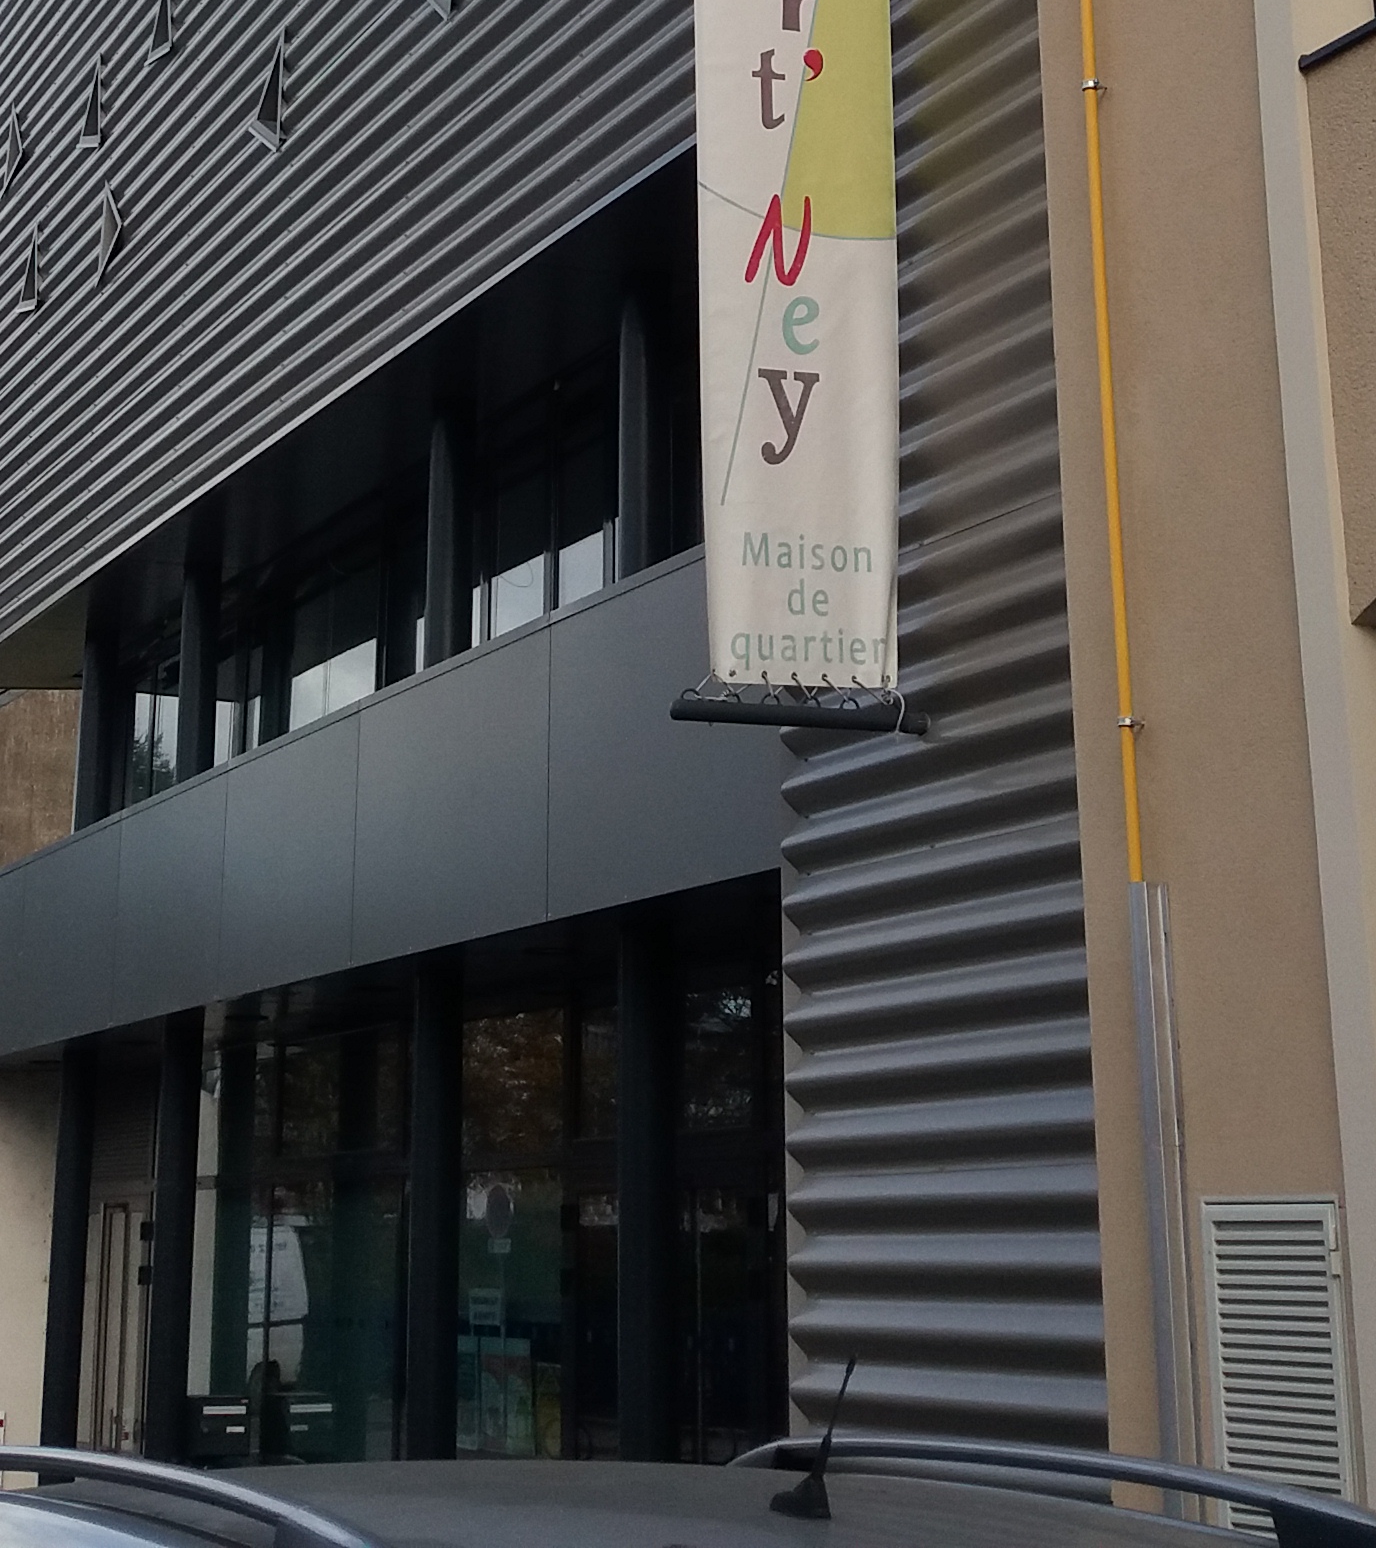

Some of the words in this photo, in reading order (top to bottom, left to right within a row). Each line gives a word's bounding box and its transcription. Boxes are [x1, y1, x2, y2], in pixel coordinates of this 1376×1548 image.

[741, 532, 873, 574] Maison
[787, 578, 830, 617] de
[730, 627, 888, 668] quartier
